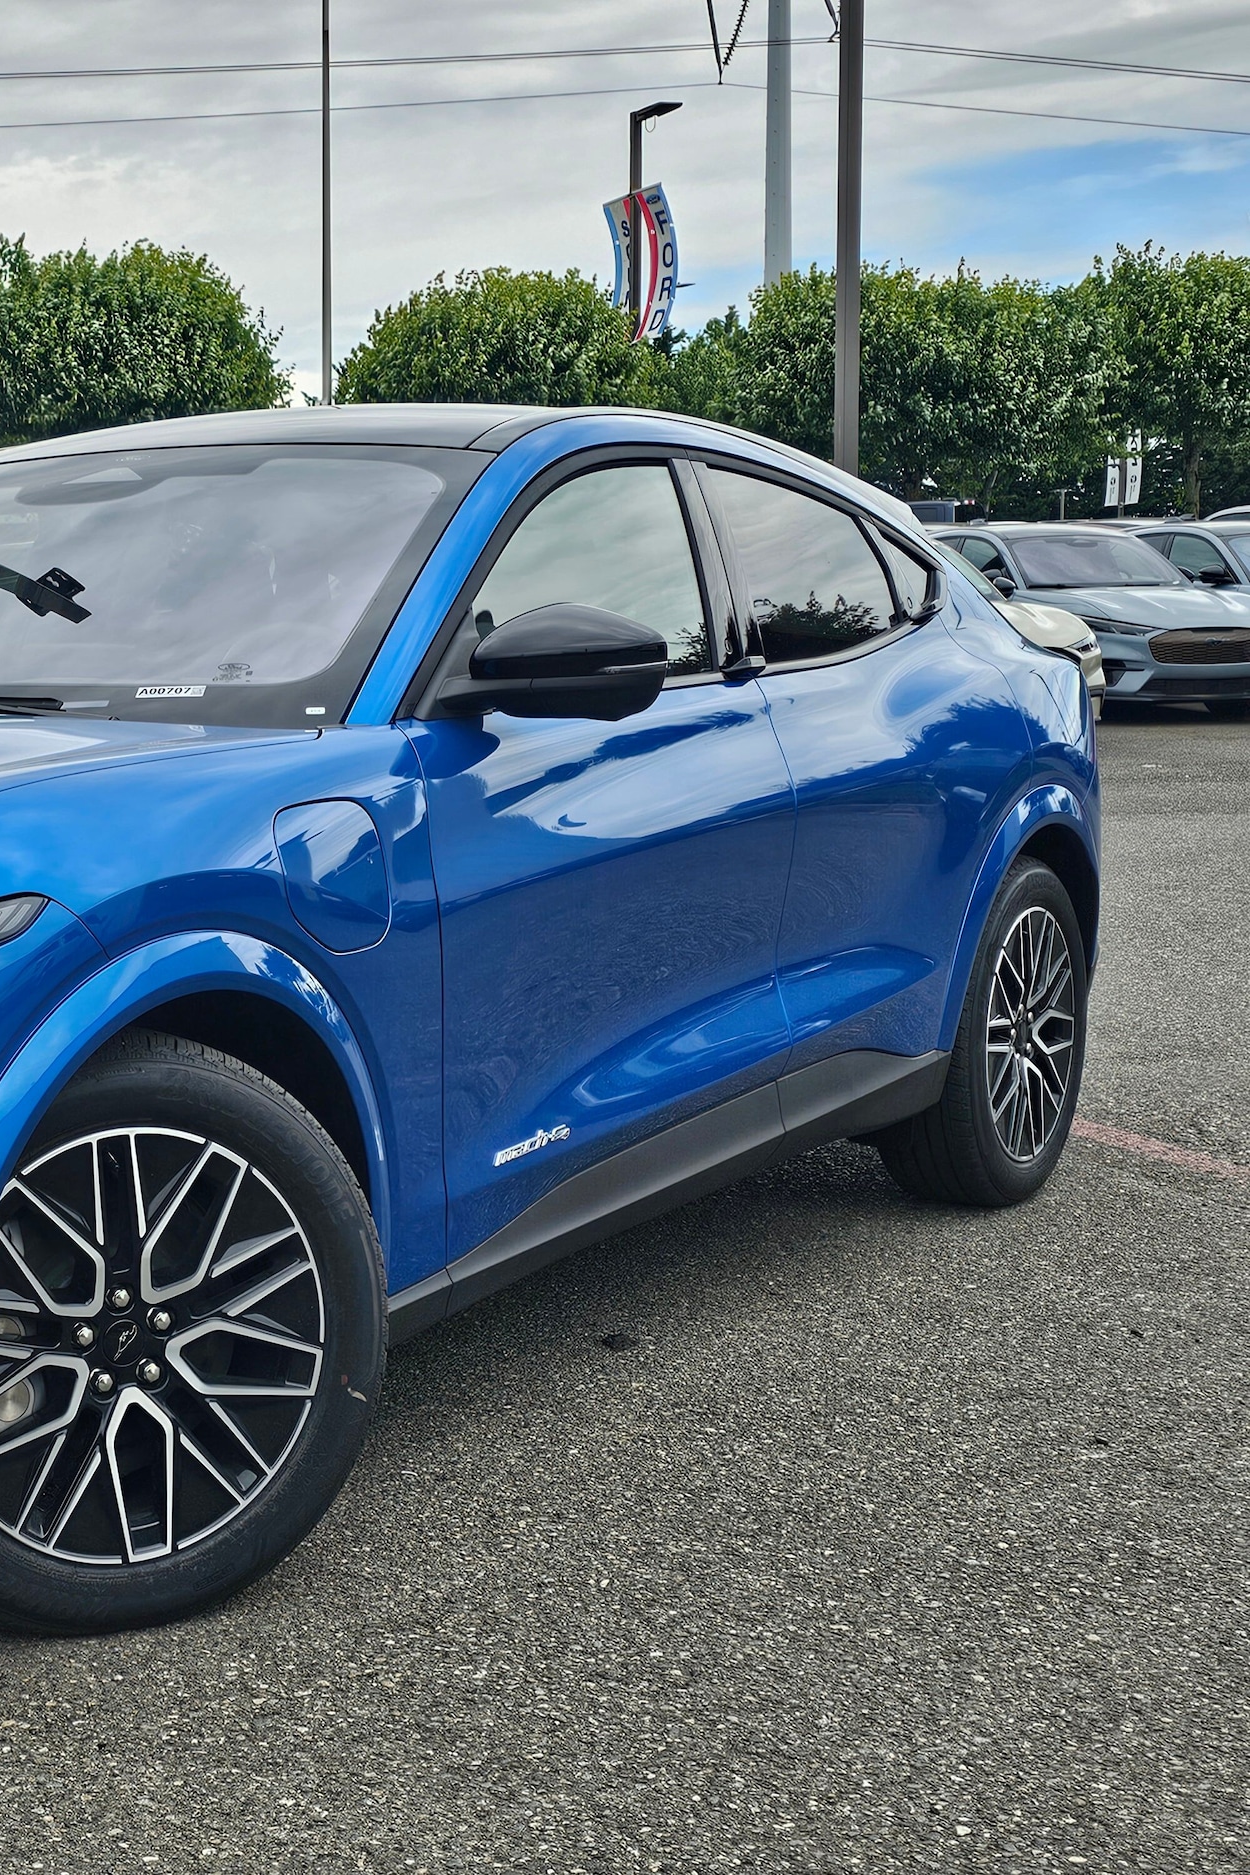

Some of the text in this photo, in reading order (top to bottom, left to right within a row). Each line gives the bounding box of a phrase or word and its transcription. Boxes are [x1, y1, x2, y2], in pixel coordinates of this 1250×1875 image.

[648, 209, 674, 332] FORD
[138, 686, 191, 697] A00707
[158, 1067, 357, 1226] BRIDGESTONE
